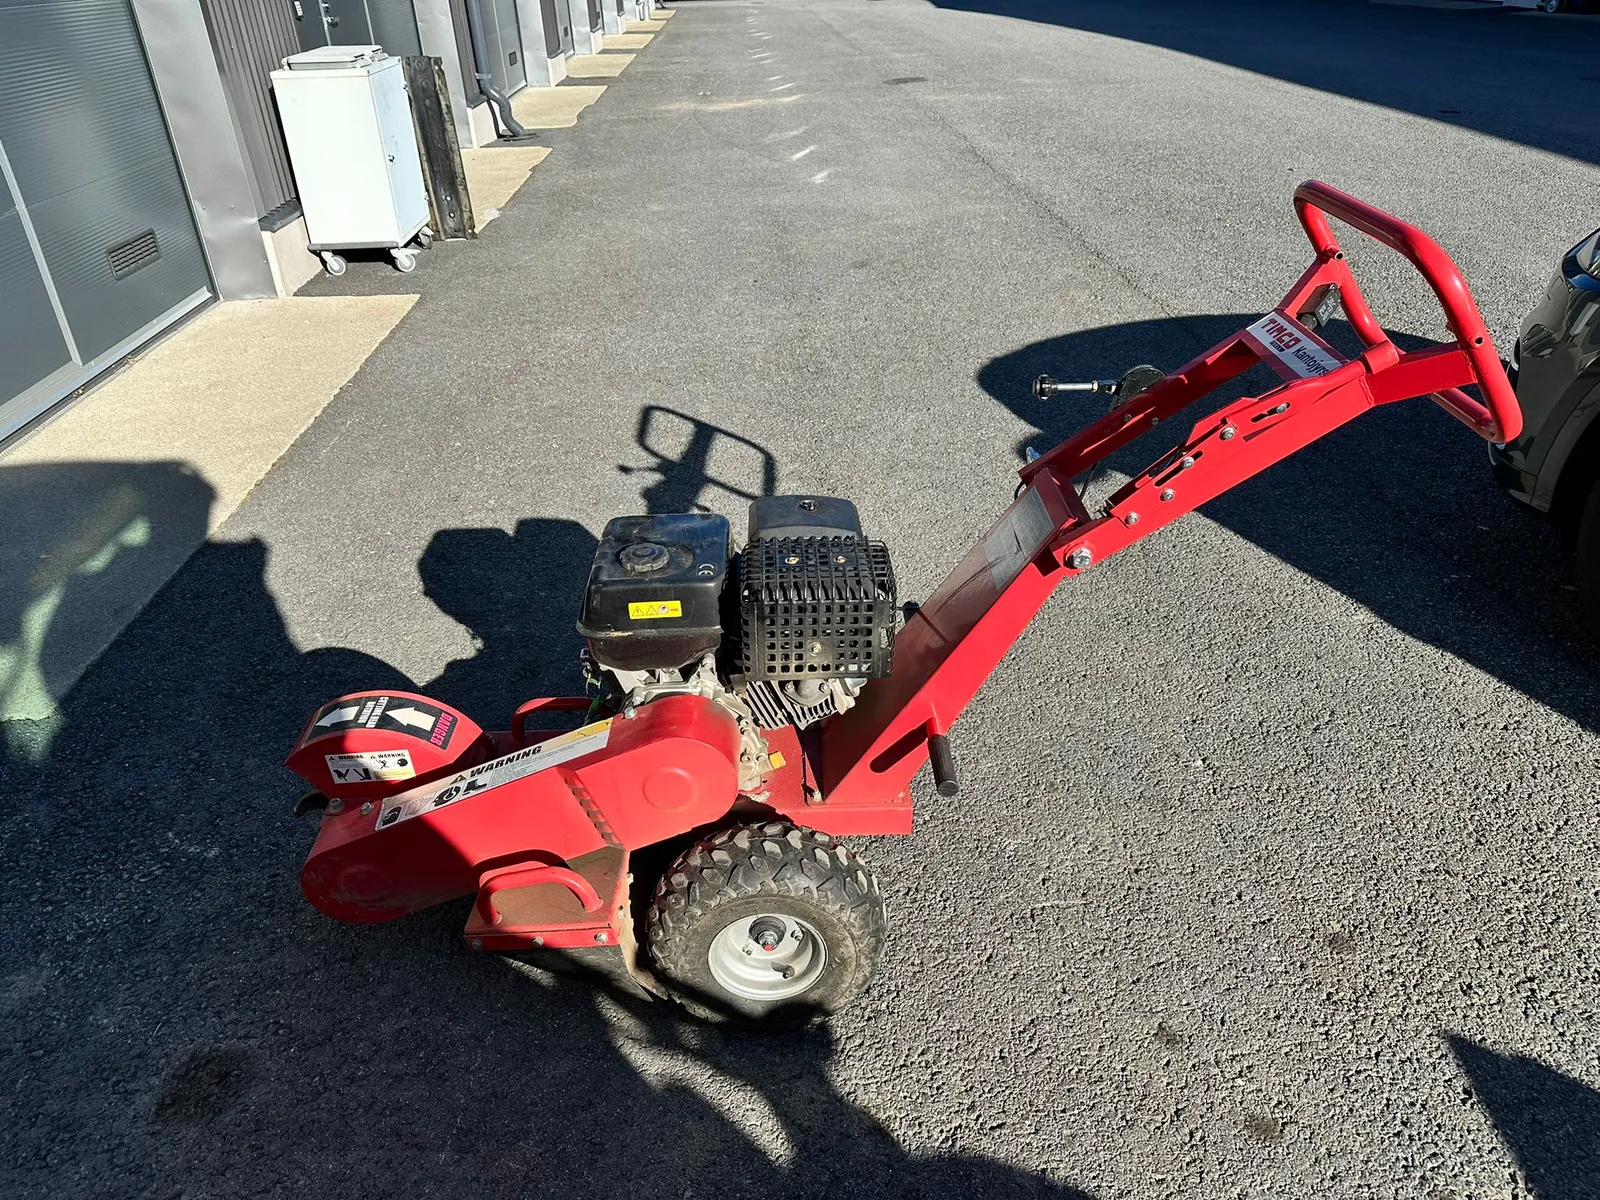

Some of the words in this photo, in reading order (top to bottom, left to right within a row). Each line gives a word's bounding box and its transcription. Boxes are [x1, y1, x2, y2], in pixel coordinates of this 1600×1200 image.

[1261, 318, 1301, 350] TIMCO
[430, 712, 453, 747] DANGER
[469, 745, 542, 777] WARNING
